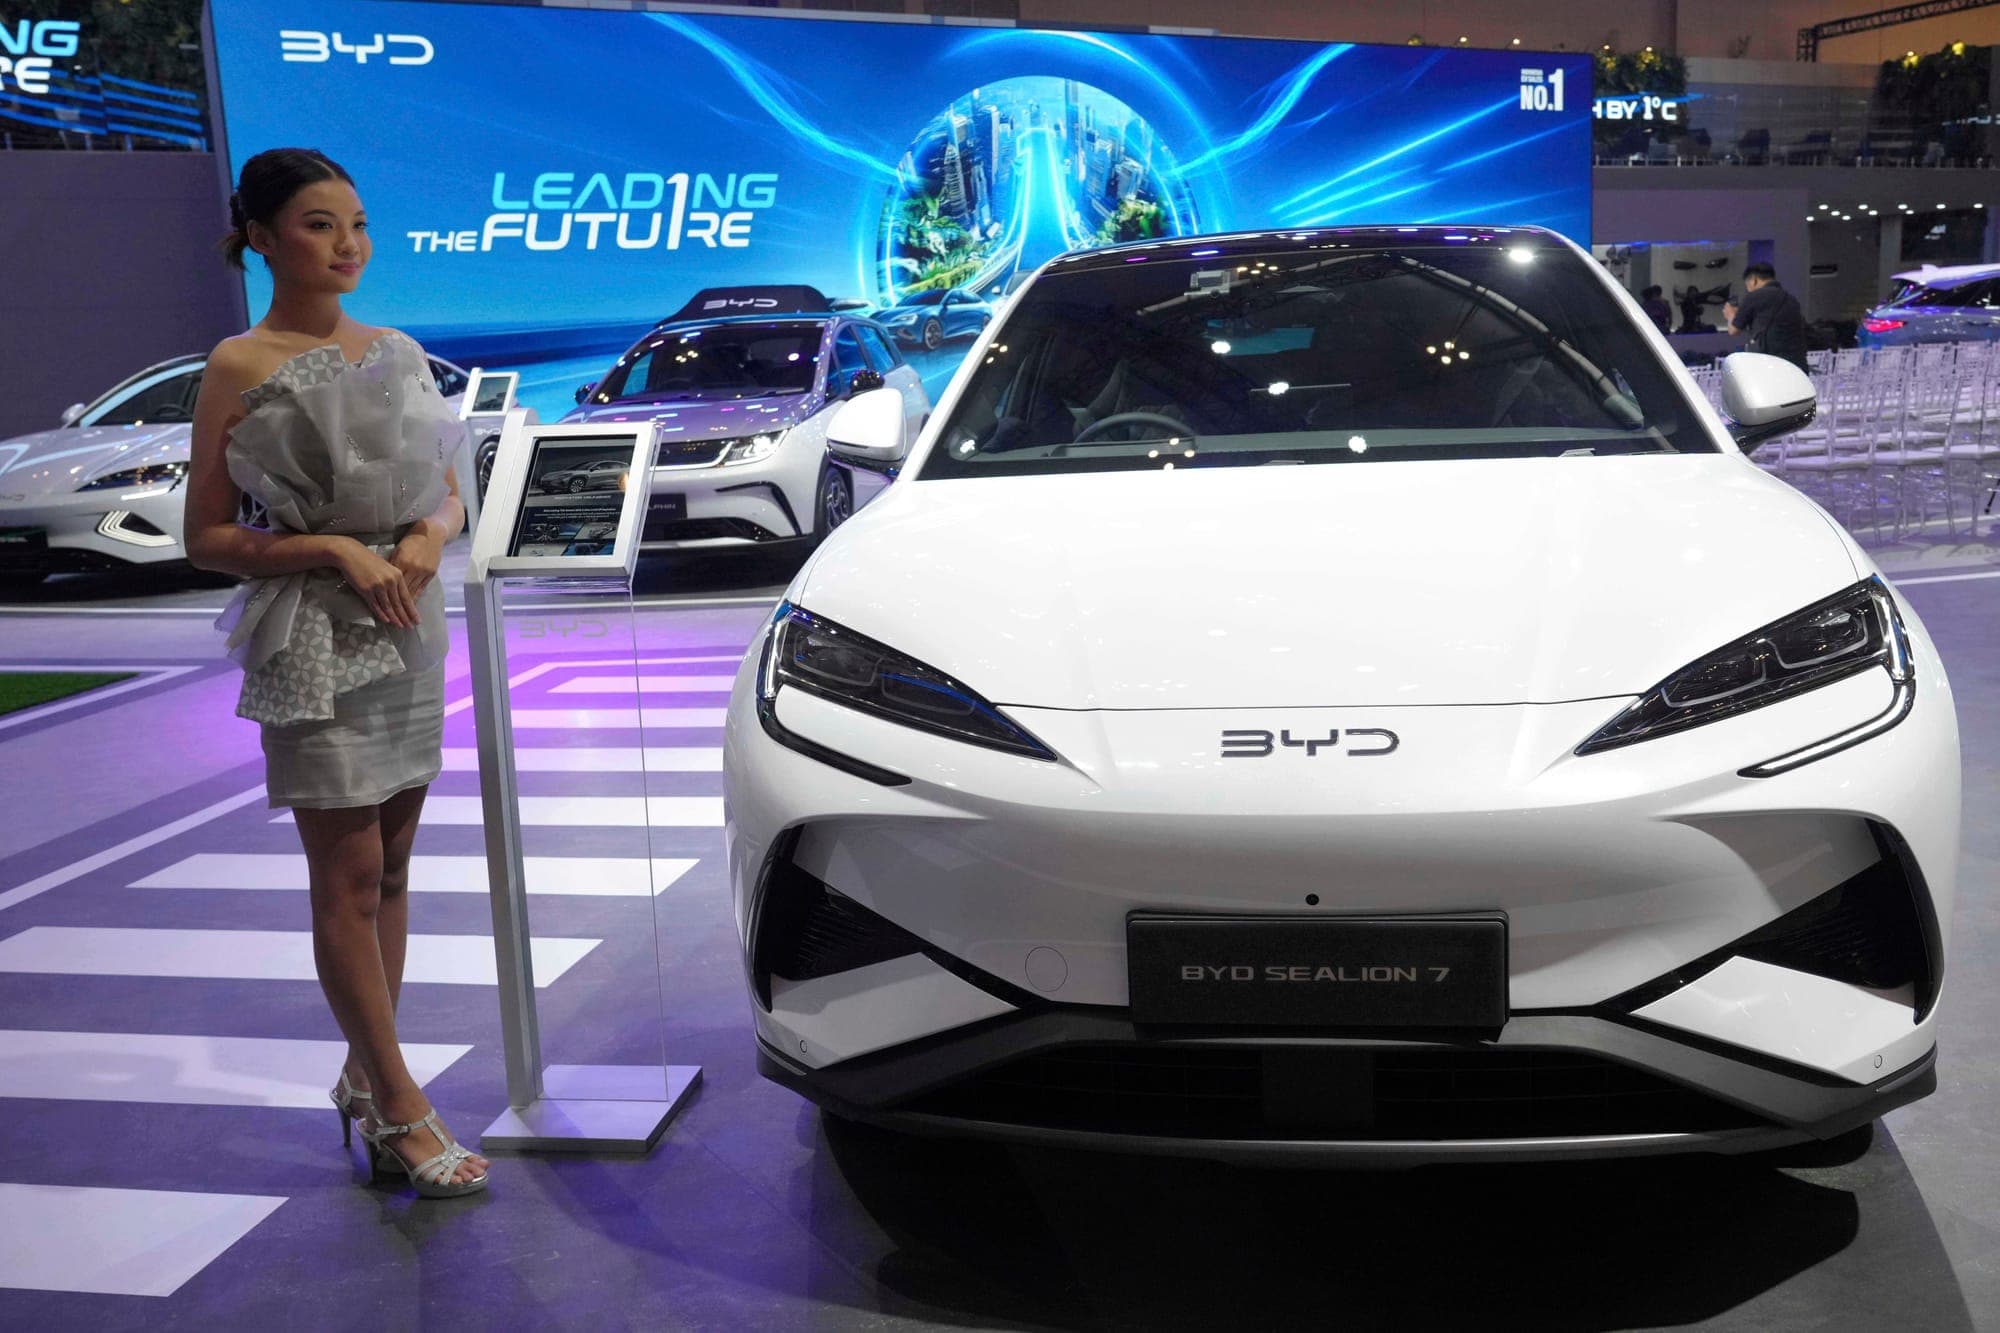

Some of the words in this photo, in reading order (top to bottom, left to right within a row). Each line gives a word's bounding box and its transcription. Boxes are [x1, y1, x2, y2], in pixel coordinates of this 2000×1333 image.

[280, 30, 434, 65] BYD
[1520, 68, 1563, 111] NO.1
[1606, 101, 1637, 119] BY
[407, 231, 477, 252] THE
[703, 298, 779, 310] BYD
[518, 618, 608, 638] BYD
[1221, 728, 1399, 758] BYD
[1181, 965, 1254, 981] BYD
[1265, 966, 1417, 982] SEALION
[1428, 967, 1450, 982] 7
